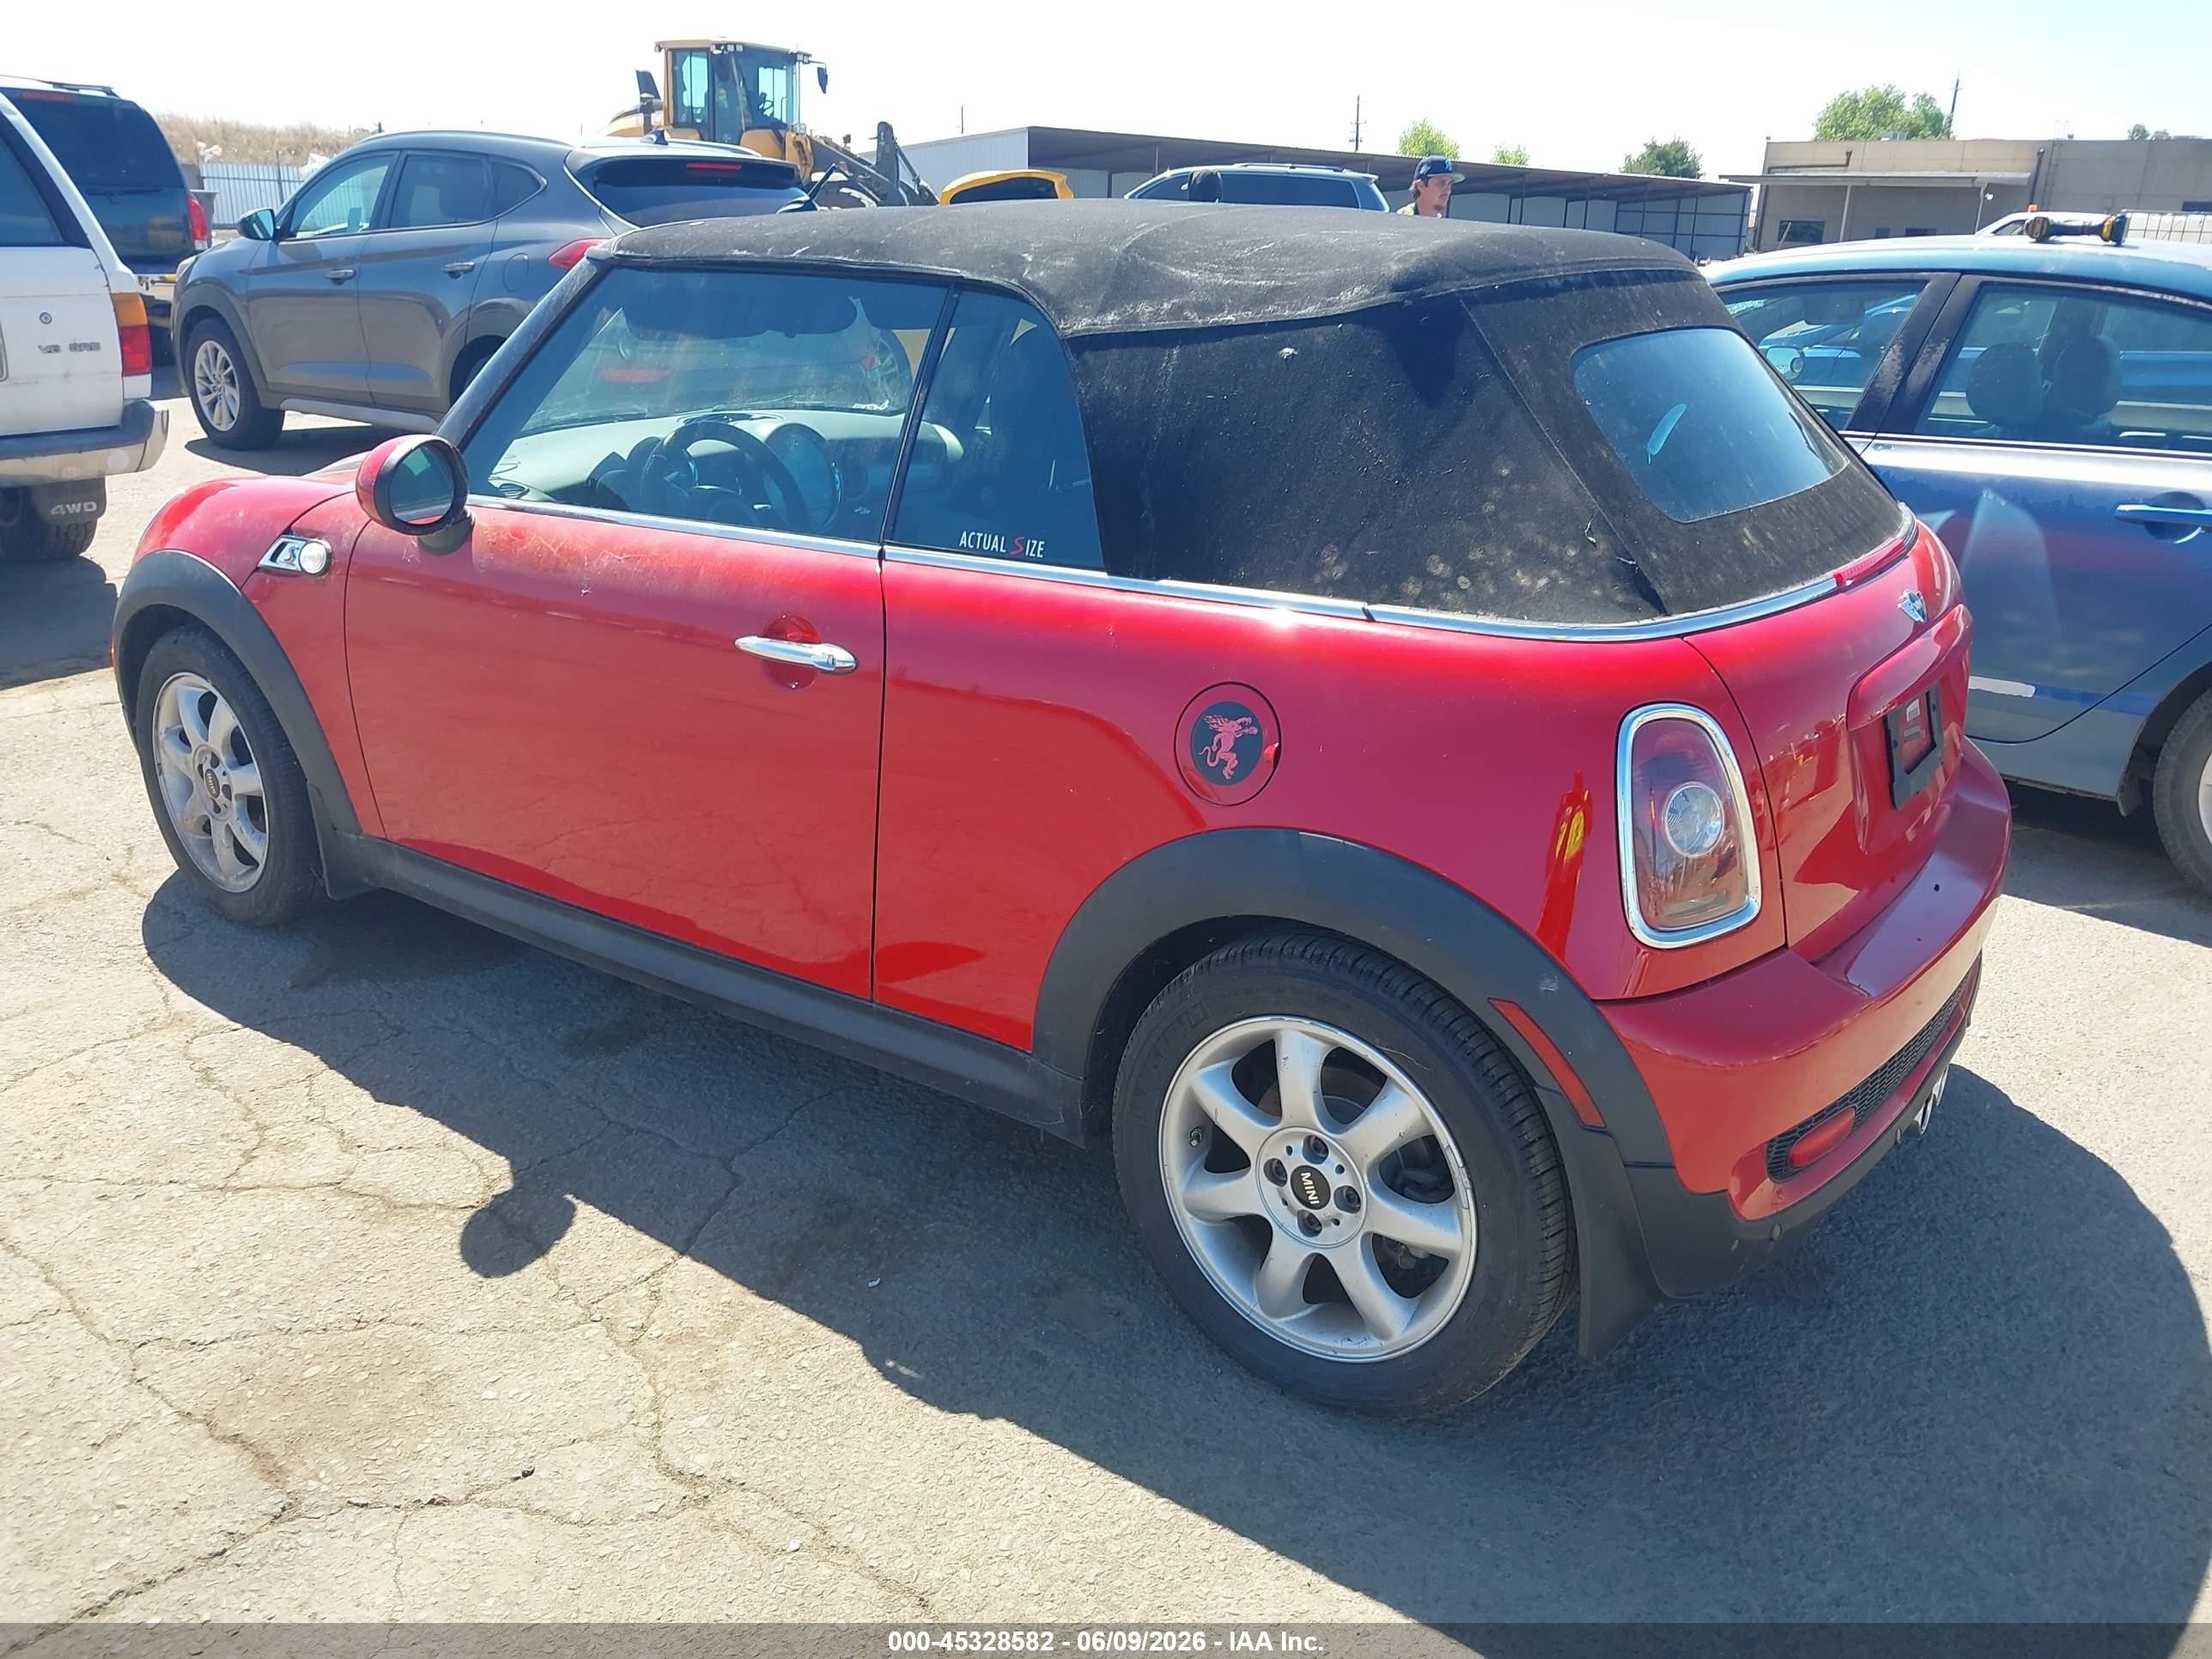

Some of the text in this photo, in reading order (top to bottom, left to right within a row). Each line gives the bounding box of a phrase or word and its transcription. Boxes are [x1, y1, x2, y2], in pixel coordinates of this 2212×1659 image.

[51, 501, 97, 515] 4WD
[958, 531, 1045, 558] ACTUAL SIZE
[1300, 1172, 1320, 1205] MINI
